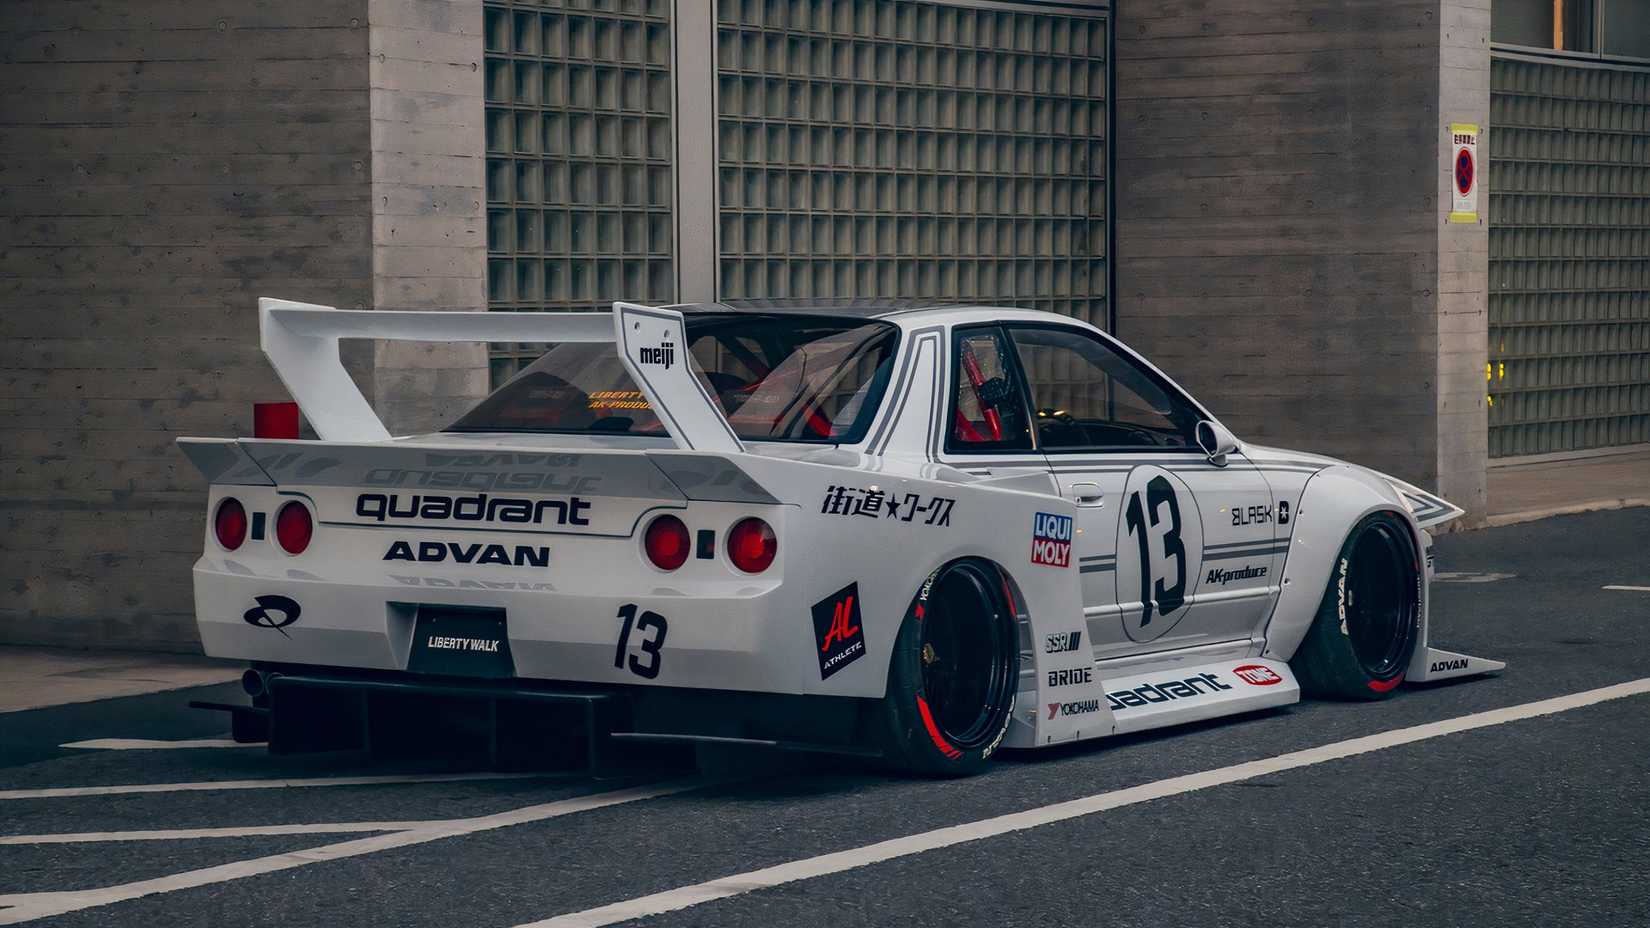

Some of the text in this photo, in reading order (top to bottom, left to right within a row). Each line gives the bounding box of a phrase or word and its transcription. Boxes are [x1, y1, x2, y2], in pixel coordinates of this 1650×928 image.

[640, 342, 674, 370] meiji
[356, 493, 591, 526] quadrant
[1035, 513, 1071, 541] LIQUI
[383, 541, 550, 567] ADVAN
[1033, 540, 1070, 567] MOLY
[1126, 475, 1186, 628] 13
[1205, 565, 1267, 585] AK-produce
[1338, 558, 1349, 635] ADVAN
[822, 596, 859, 652] AL
[428, 636, 499, 652] LIBERTY WALK
[614, 603, 668, 680] 13
[823, 641, 862, 670] ATHLETE
[1046, 632, 1067, 654] SSR
[1048, 667, 1092, 687] BRIDE
[1430, 659, 1468, 673] ADVAN
[1105, 672, 1232, 711] uadrant
[1060, 699, 1099, 716] YOKOHAMA
